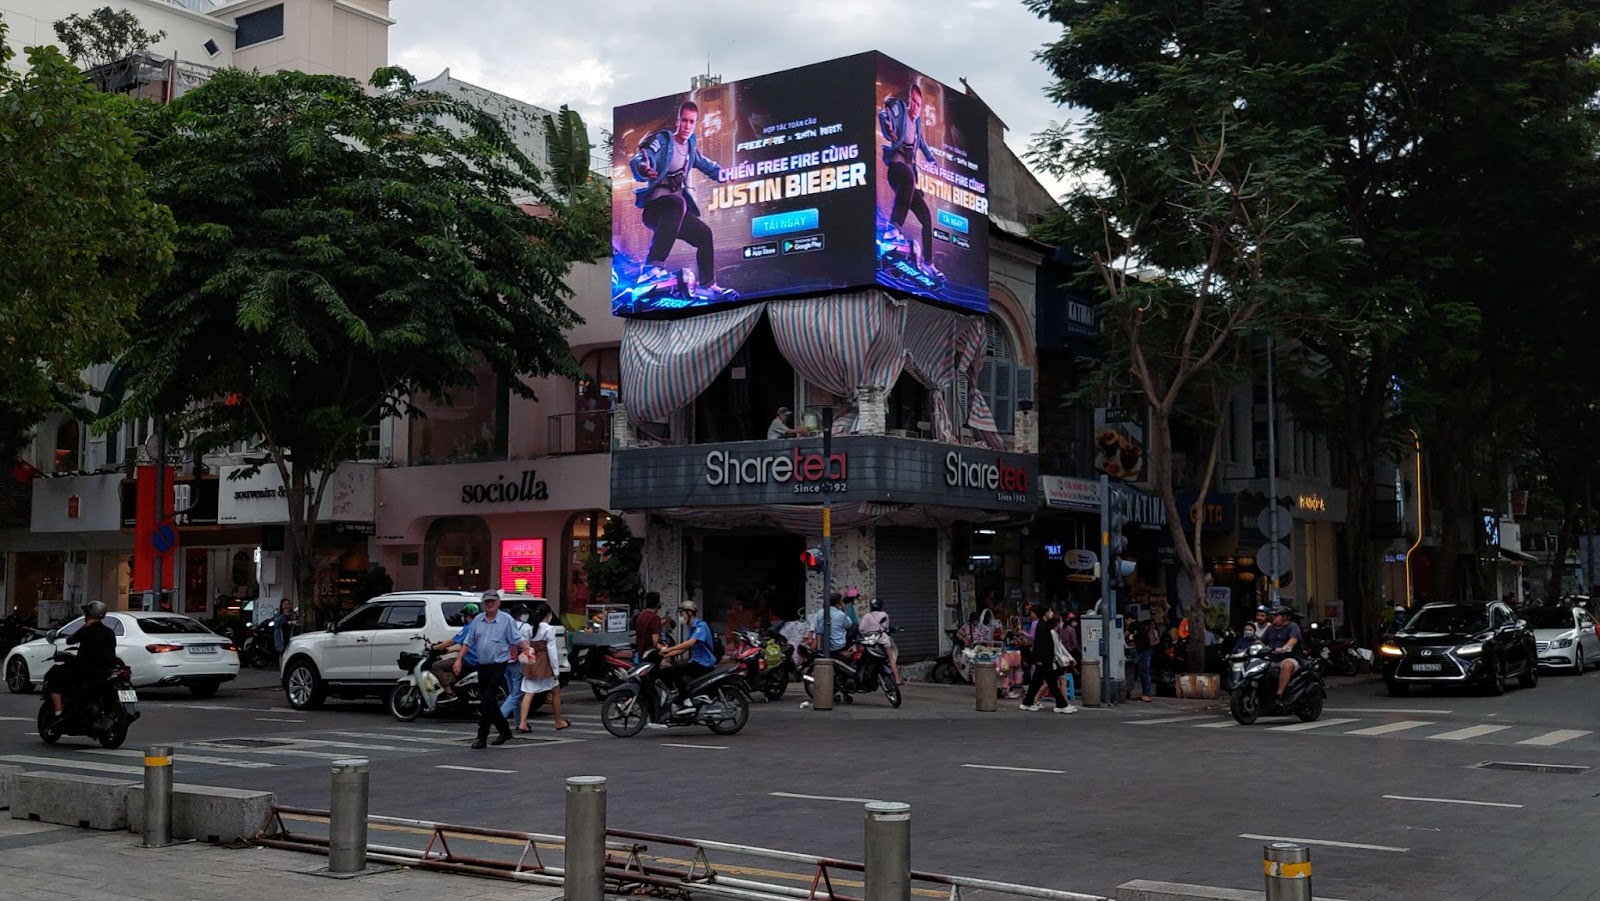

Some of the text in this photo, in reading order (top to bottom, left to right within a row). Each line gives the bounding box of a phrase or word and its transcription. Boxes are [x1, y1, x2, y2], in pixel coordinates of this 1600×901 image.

[776, 123, 787, 132] TÁC
[718, 144, 859, 182] CHIẾN FREE FIRE CÙNG
[920, 160, 986, 193] CHIẾN FREE FIRE CÙNG
[707, 162, 868, 212] JUSTIN BIEBER
[915, 172, 989, 216] JUSTIN BIEBER
[780, 216, 807, 229] NGAY
[751, 249, 763, 257] App
[763, 246, 776, 255] Store
[794, 240, 823, 252] Google Play
[705, 446, 847, 486] Sharetea
[946, 451, 1028, 492] Sharetea
[233, 486, 286, 499] souvenirs &
[461, 470, 549, 504] sociolla
[793, 483, 820, 493] Since
[997, 492, 1026, 504] Since 1992
[1126, 493, 1167, 525] KATINA
